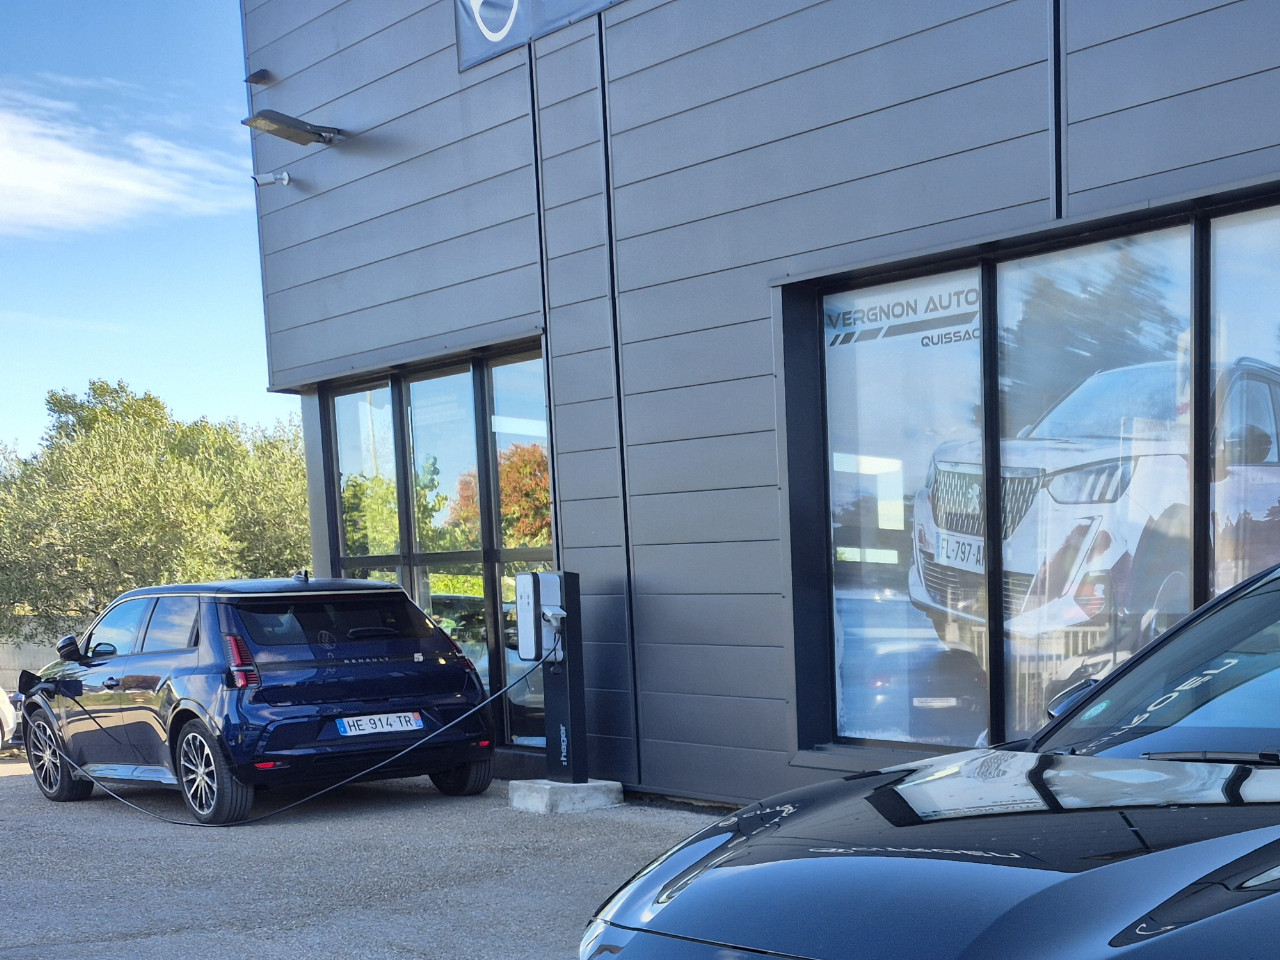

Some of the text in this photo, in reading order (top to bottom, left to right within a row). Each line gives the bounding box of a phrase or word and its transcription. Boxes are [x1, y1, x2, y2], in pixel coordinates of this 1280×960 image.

[827, 287, 981, 330] VERGNON AUTO
[559, 724, 568, 761] hager
